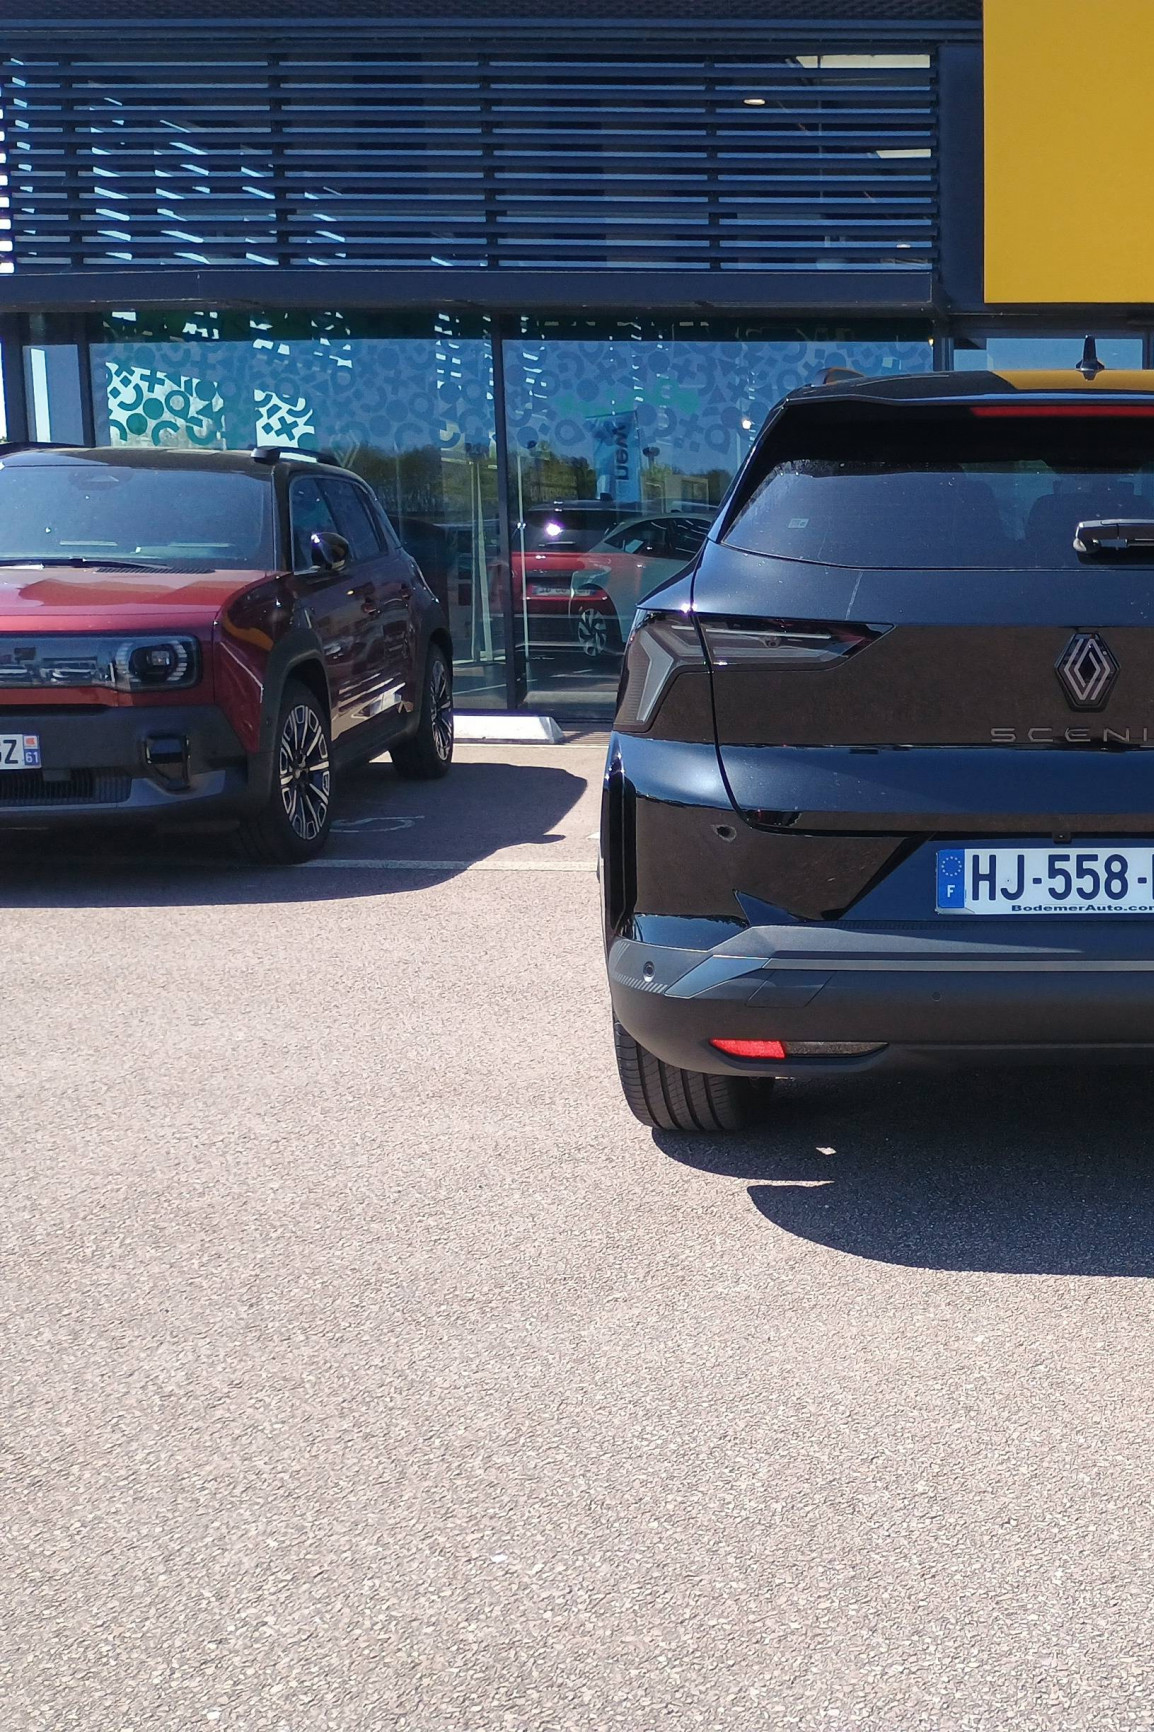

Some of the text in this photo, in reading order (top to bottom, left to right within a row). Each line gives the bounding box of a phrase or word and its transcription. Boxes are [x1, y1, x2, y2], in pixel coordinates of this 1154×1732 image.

[0, 739, 18, 764] Z
[25, 751, 39, 764] 61
[947, 884, 956, 898] F
